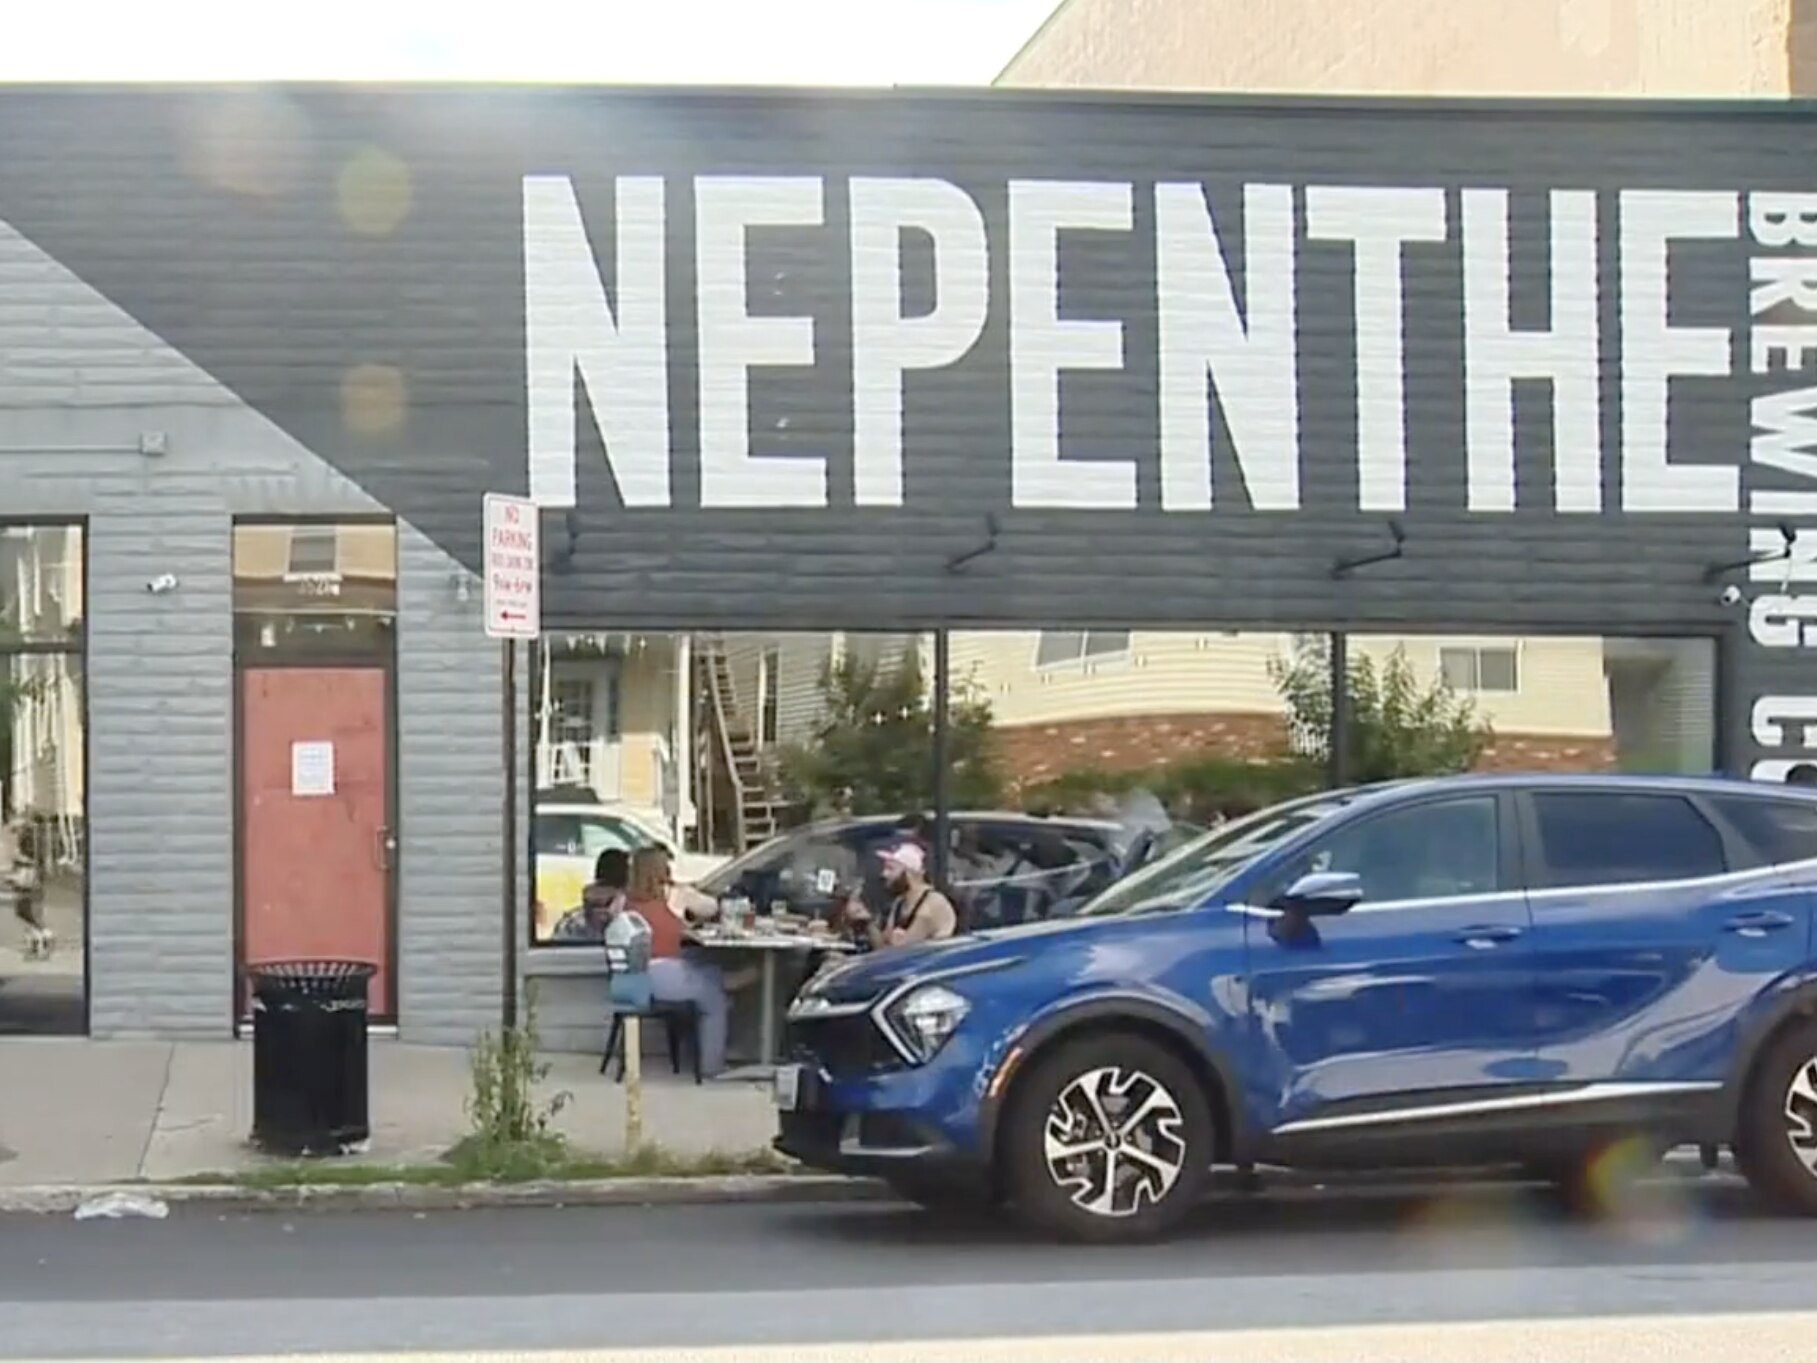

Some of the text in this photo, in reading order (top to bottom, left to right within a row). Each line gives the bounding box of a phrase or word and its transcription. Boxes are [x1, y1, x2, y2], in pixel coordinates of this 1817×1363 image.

[522, 174, 1741, 513] NEPENTHE
[1748, 191, 1817, 647] BREWING
[491, 526, 533, 552] PARKING
[504, 504, 520, 524] NO
